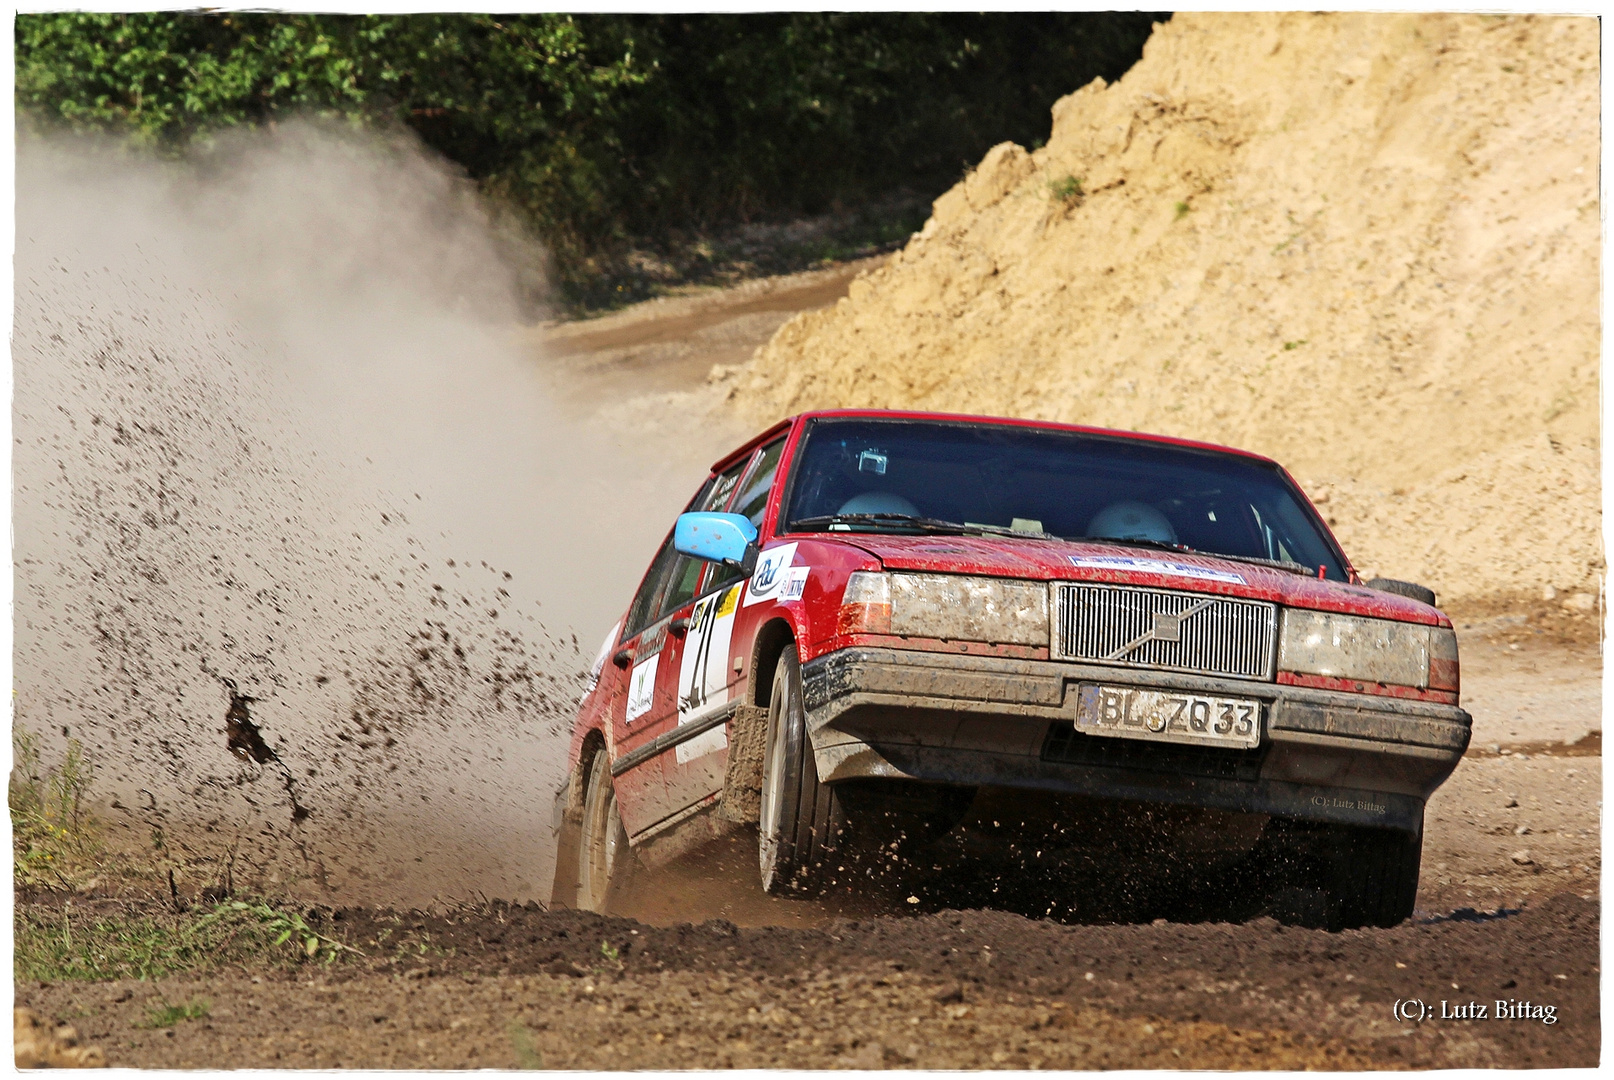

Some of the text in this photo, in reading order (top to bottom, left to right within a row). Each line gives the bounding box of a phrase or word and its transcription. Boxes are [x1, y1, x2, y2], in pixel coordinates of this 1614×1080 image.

[1101, 692, 1255, 736] BL ZQ 33
